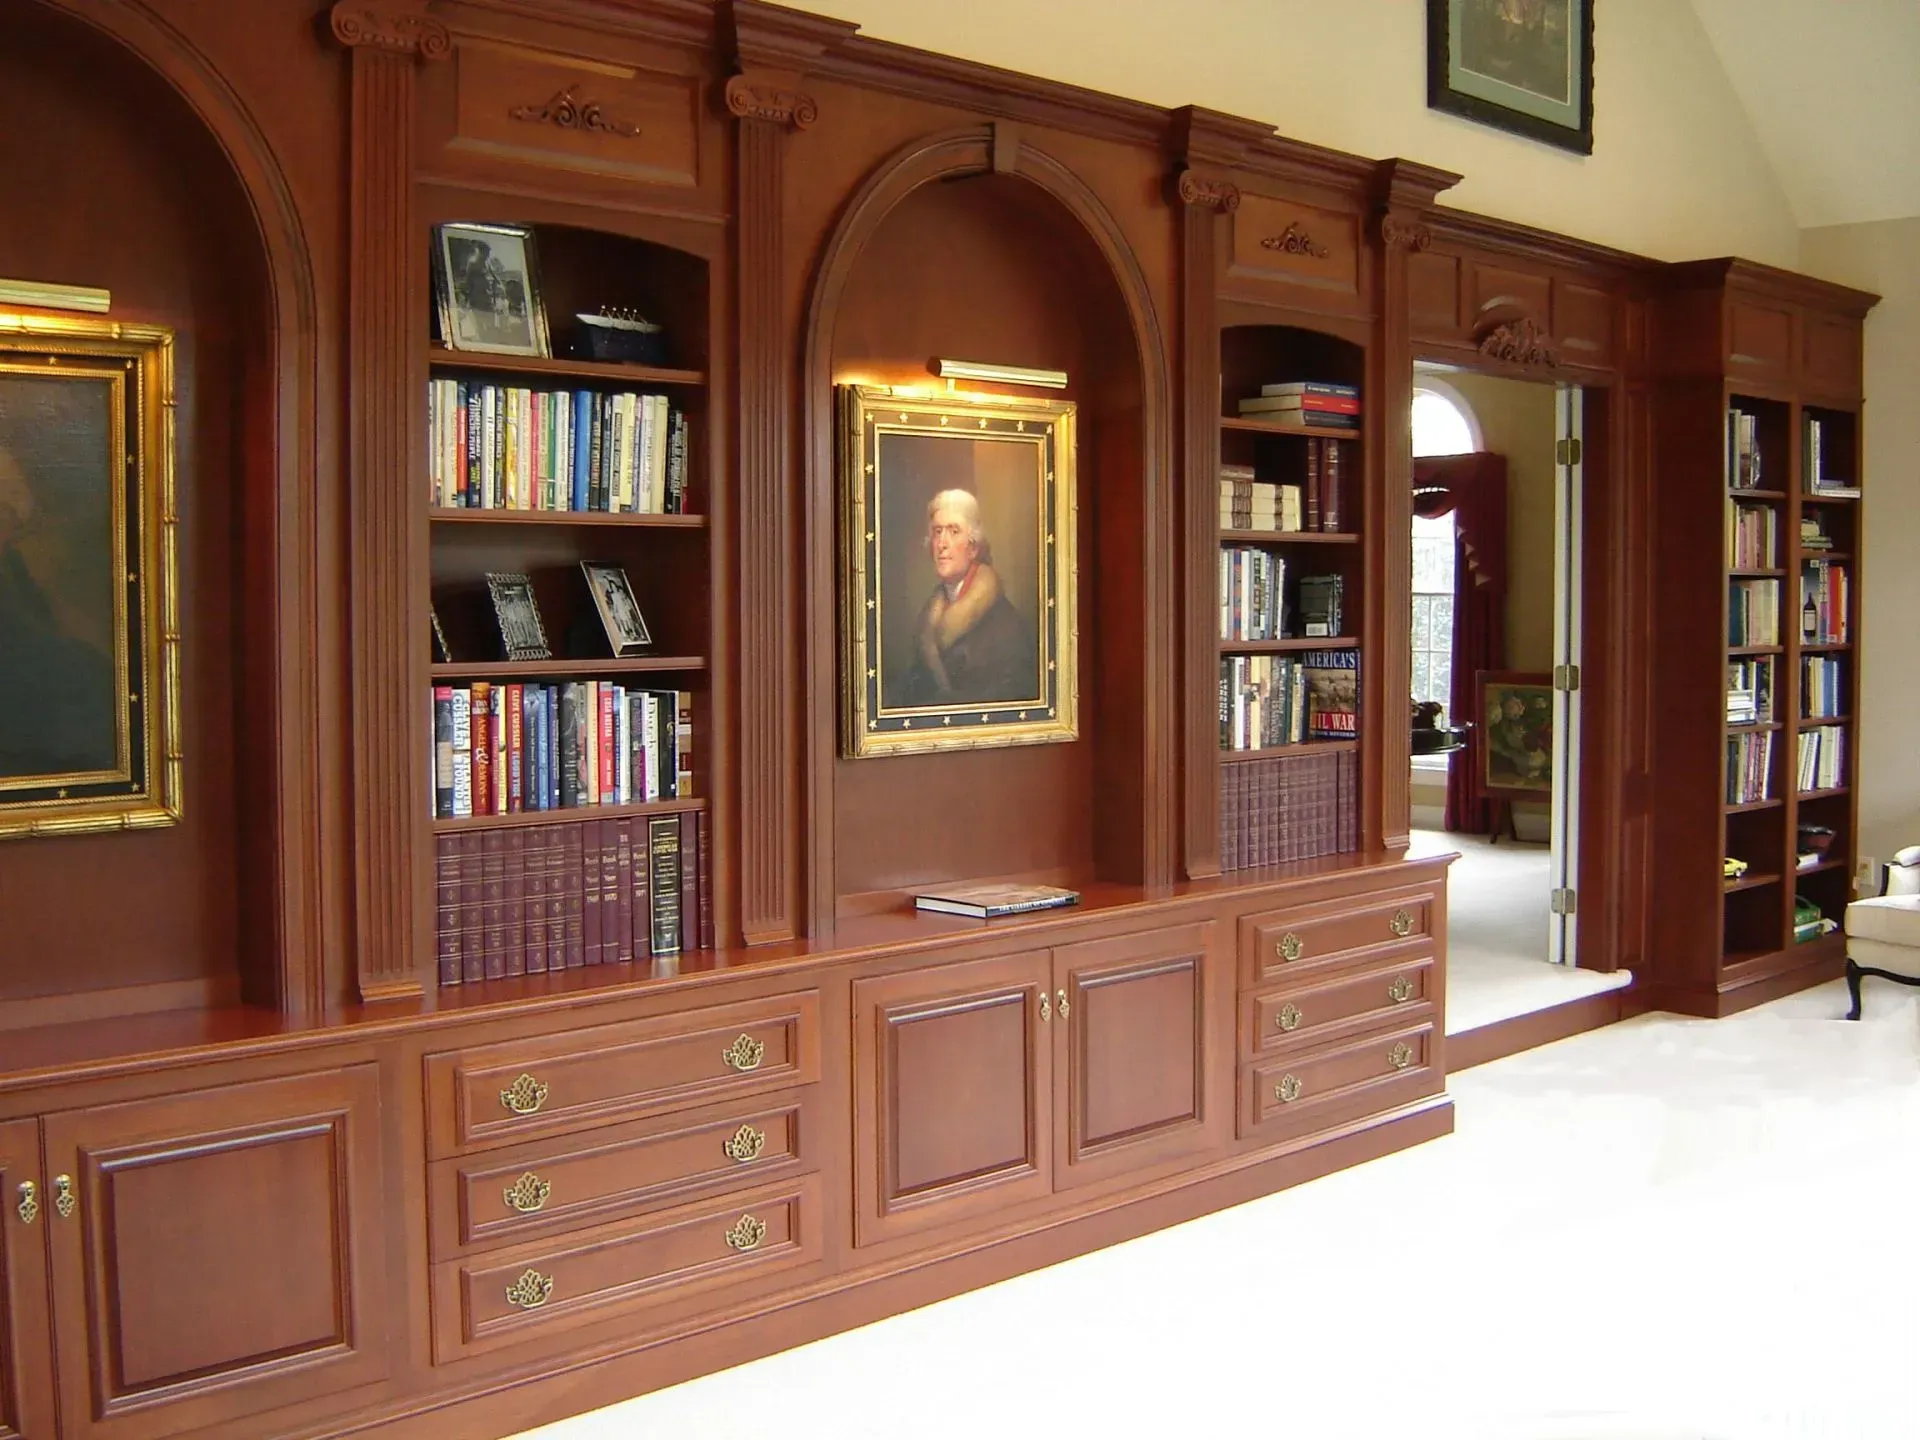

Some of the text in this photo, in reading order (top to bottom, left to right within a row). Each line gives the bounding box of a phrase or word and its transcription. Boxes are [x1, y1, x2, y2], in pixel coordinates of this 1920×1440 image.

[1301, 651, 1355, 668] AMERICA'S
[511, 689, 520, 711] CLIVE
[454, 695, 464, 746] CUSSLER
[511, 712, 520, 748] CUSSLER
[1331, 713, 1355, 731] WAR
